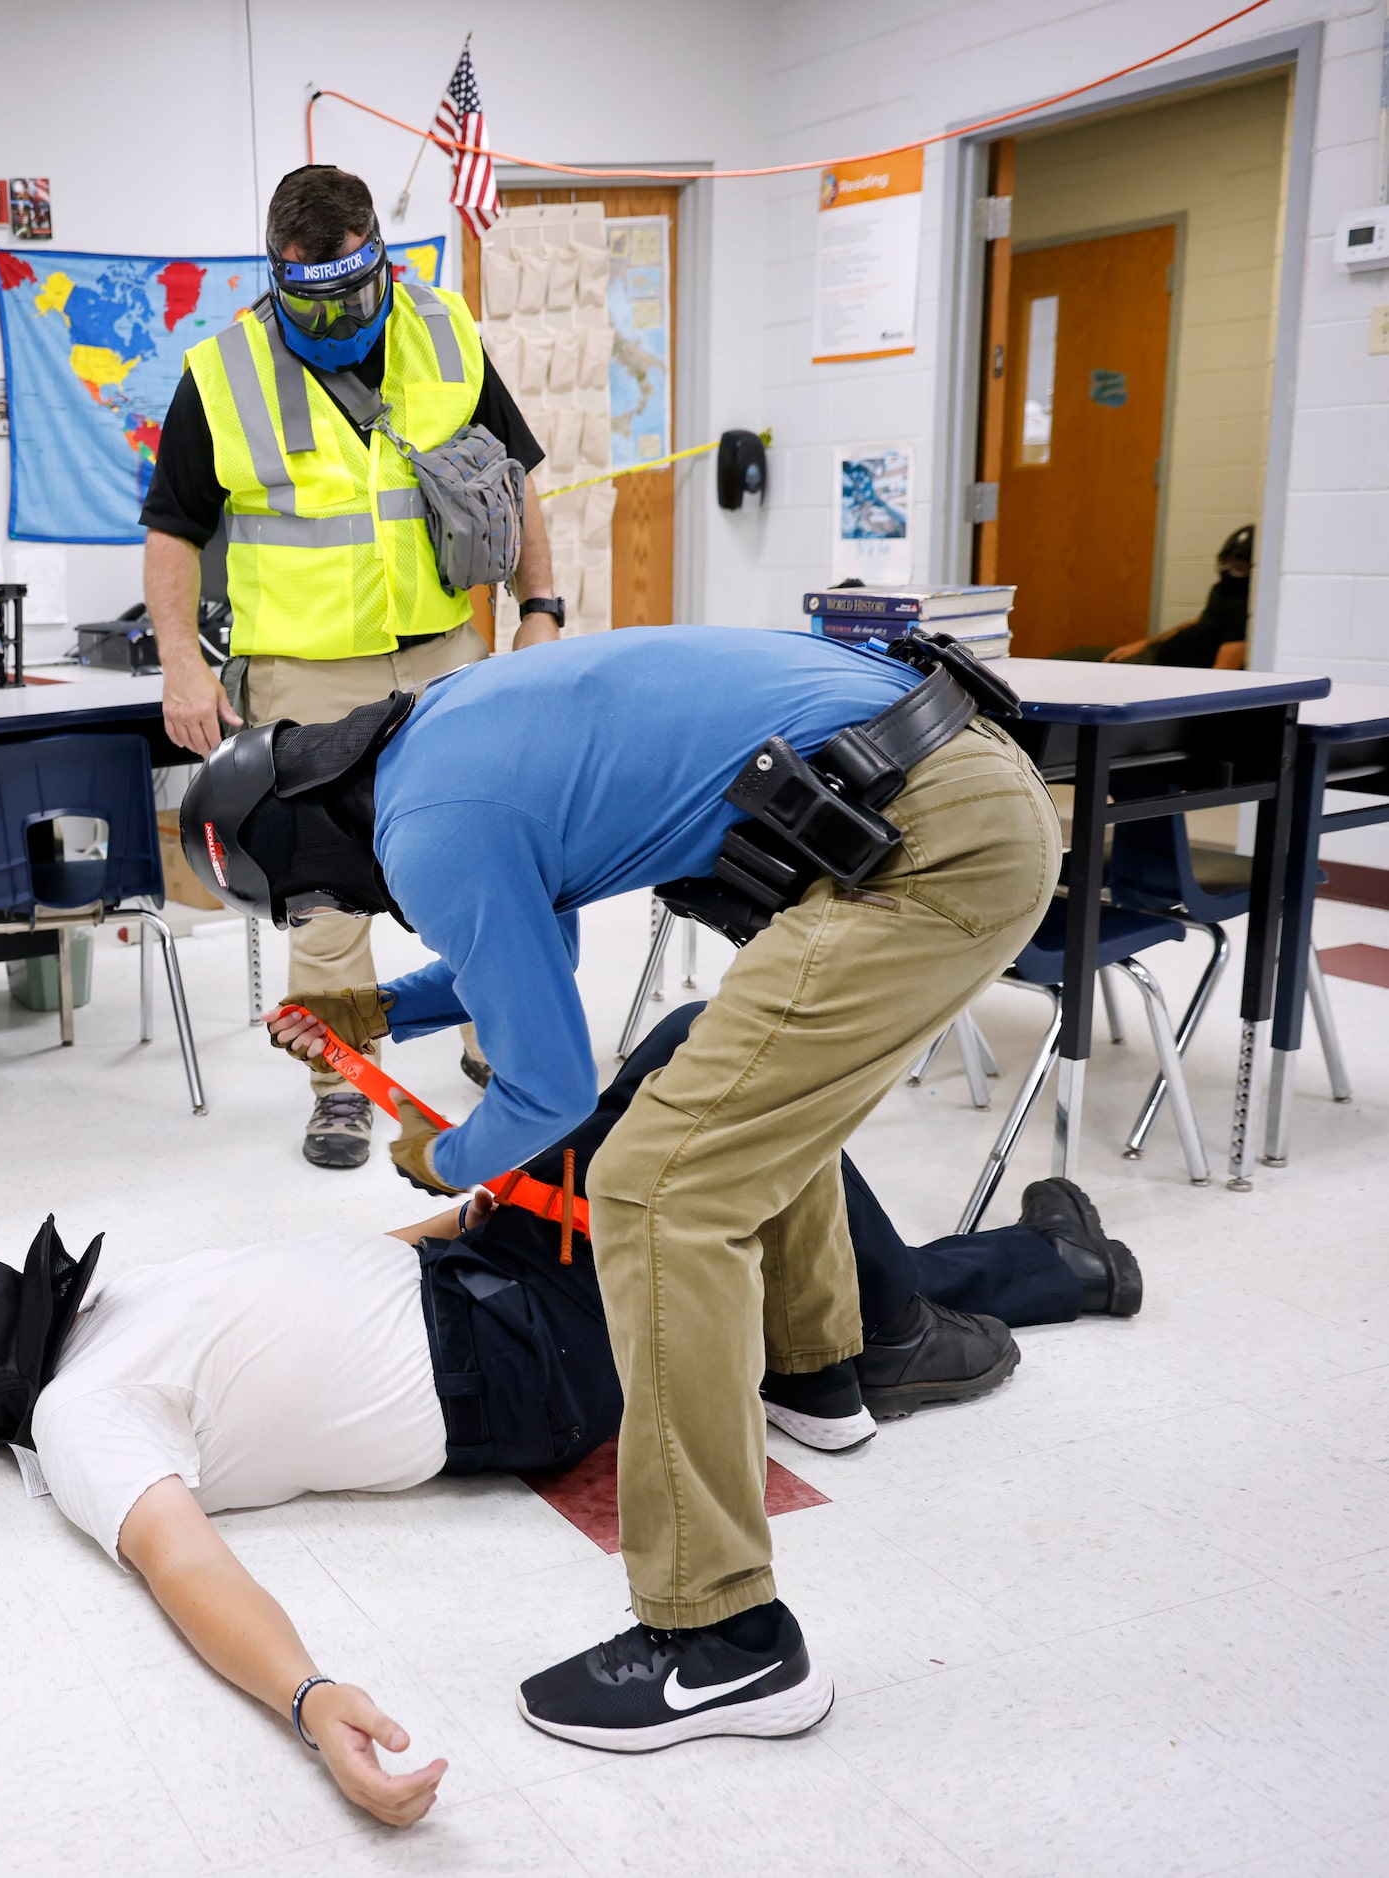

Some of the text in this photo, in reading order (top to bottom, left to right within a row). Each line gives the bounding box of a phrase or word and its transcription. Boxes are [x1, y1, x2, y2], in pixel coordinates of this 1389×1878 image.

[839, 172, 891, 194] Reading
[304, 253, 365, 280] INSTRUCTOR
[826, 598, 853, 612] WORLD
[854, 599, 887, 614] HISTORY
